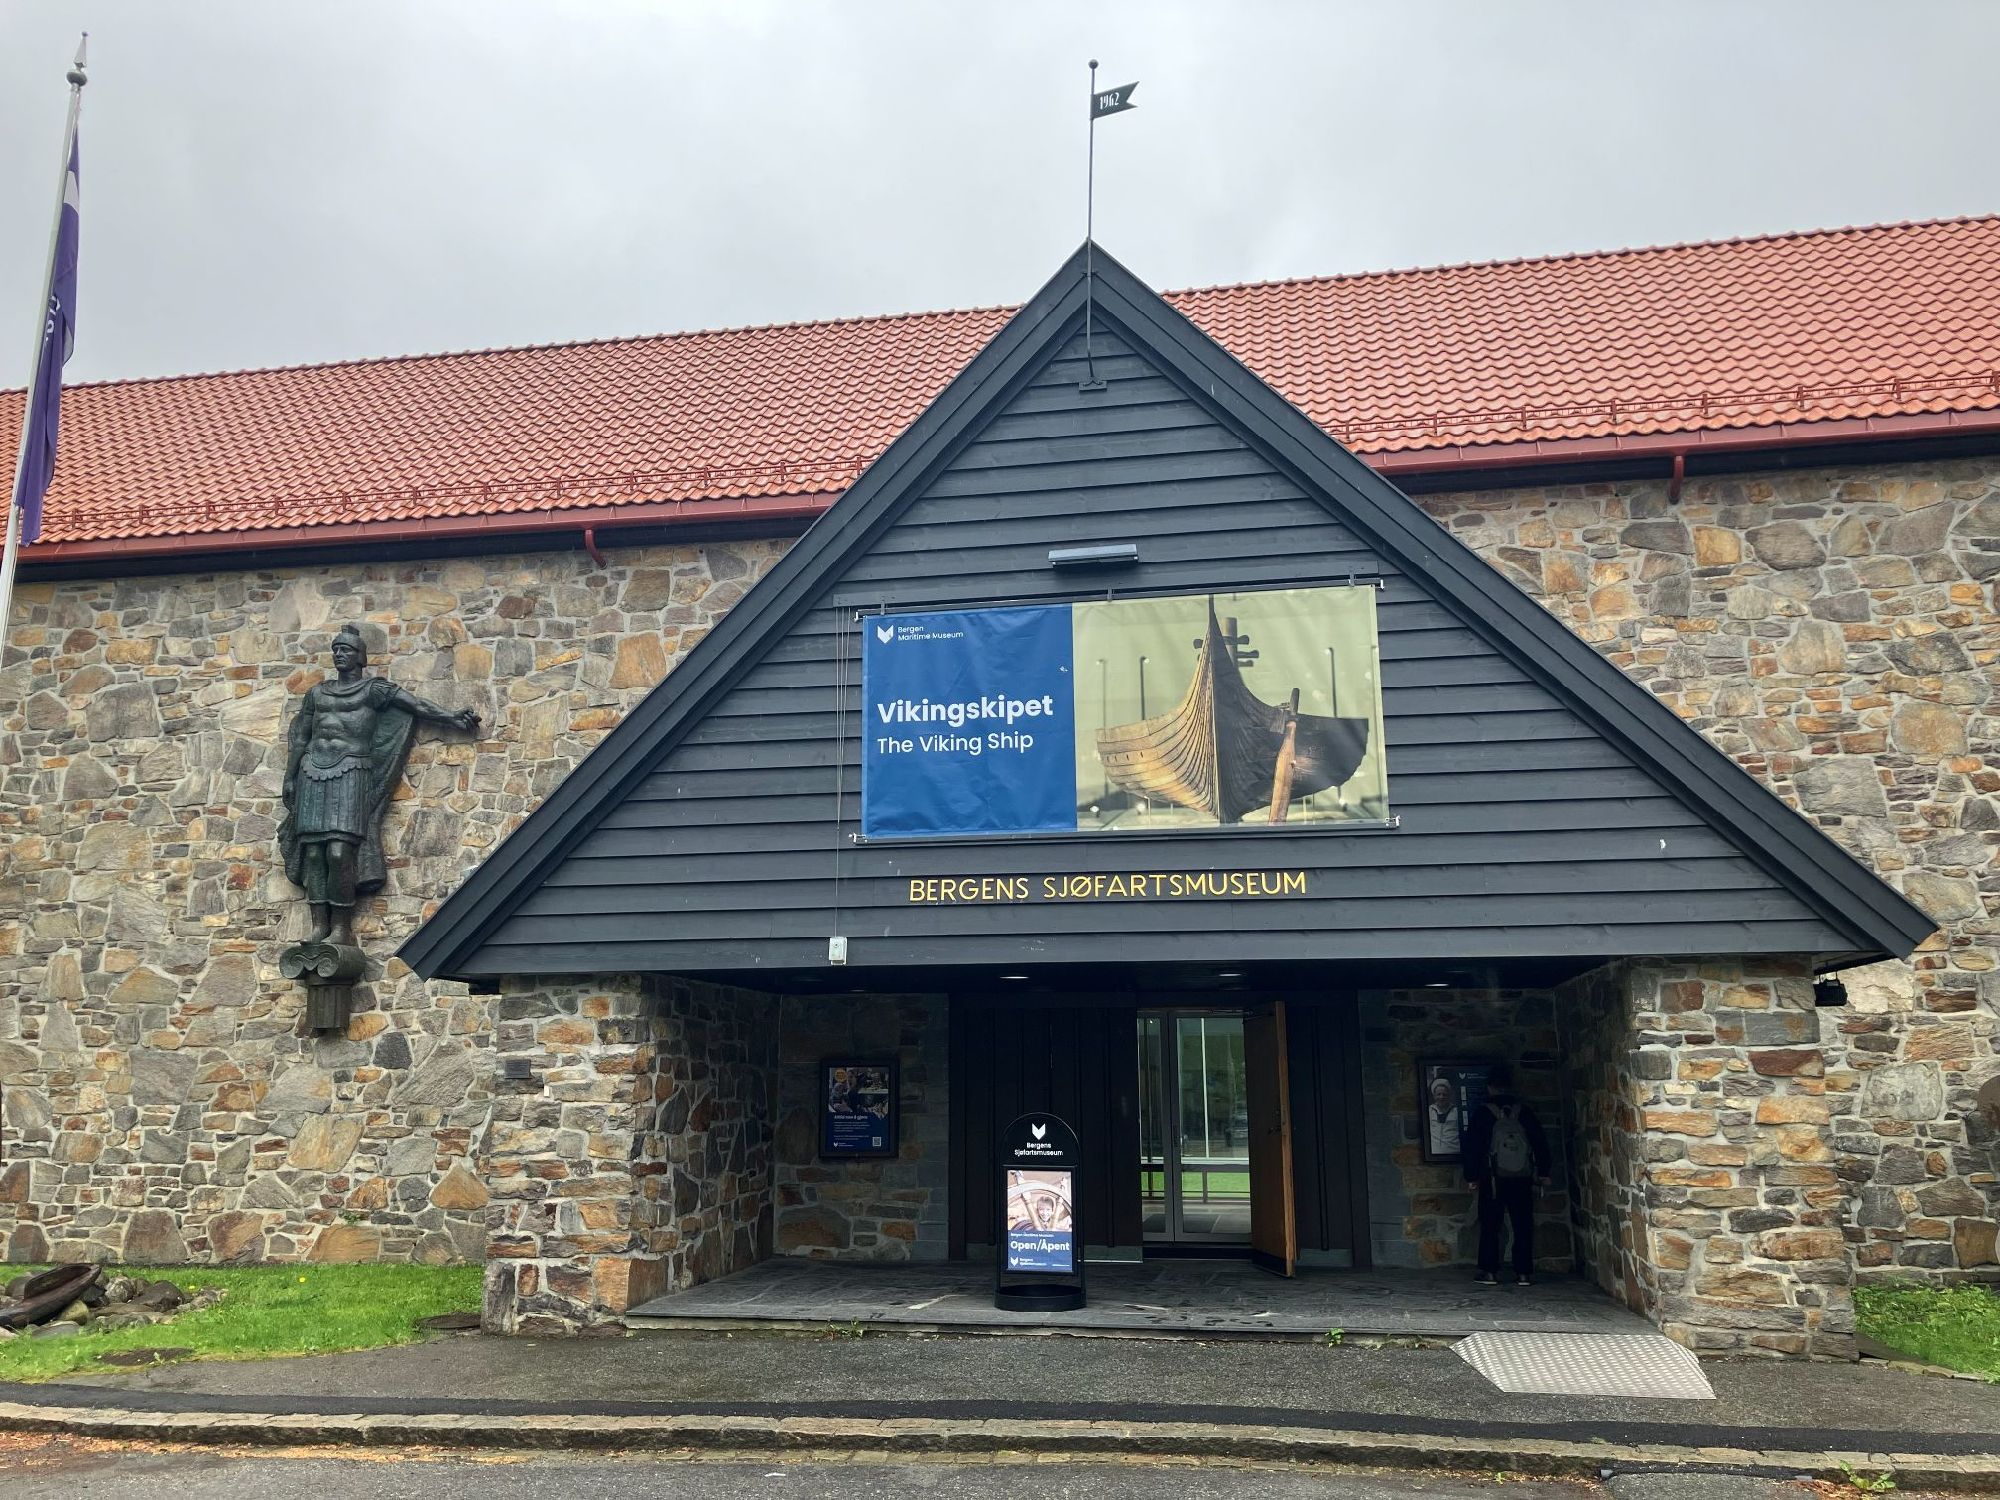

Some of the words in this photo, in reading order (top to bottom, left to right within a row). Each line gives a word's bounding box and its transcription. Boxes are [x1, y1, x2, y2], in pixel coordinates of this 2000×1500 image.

[1099, 92, 1120, 110] 1962
[898, 625, 924, 634] Bergen
[898, 632, 931, 641] Maritime
[932, 631, 964, 639] Museum
[877, 694, 1054, 728] Vikingskipet
[877, 738, 914, 754] The
[919, 734, 982, 756] Viking
[988, 731, 1034, 753] Ship
[909, 877, 1029, 902] BERGENS
[1043, 872, 1307, 899] SJØFARTSMUSEUM
[1014, 1149, 1064, 1157] Sjøfartsmuseum
[1026, 1142, 1052, 1150] Bergens
[1010, 1239, 1070, 1253] Open/Åpent
